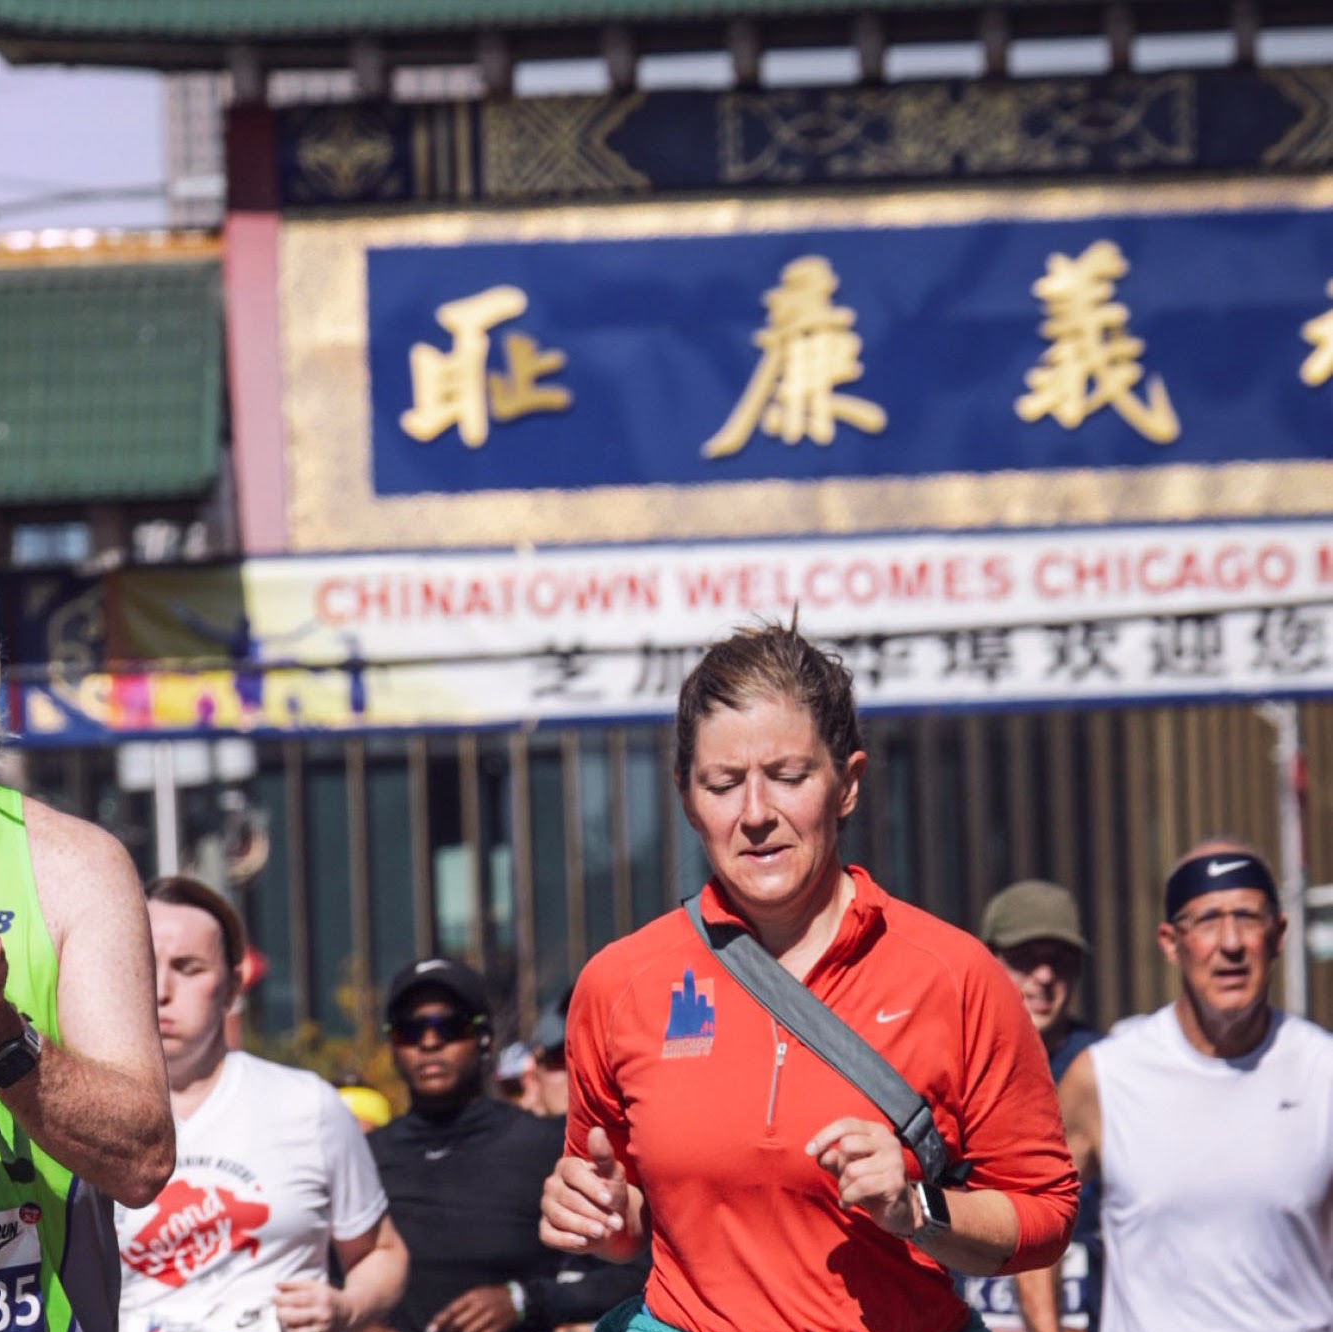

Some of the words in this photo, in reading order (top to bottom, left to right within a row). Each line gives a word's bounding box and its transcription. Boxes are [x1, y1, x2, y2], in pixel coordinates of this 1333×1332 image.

[315, 566, 659, 625] CHINATOWN
[680, 550, 1013, 608] WELCOMES
[1033, 542, 1297, 598] CHICAGO
[121, 1187, 227, 1275] Second
